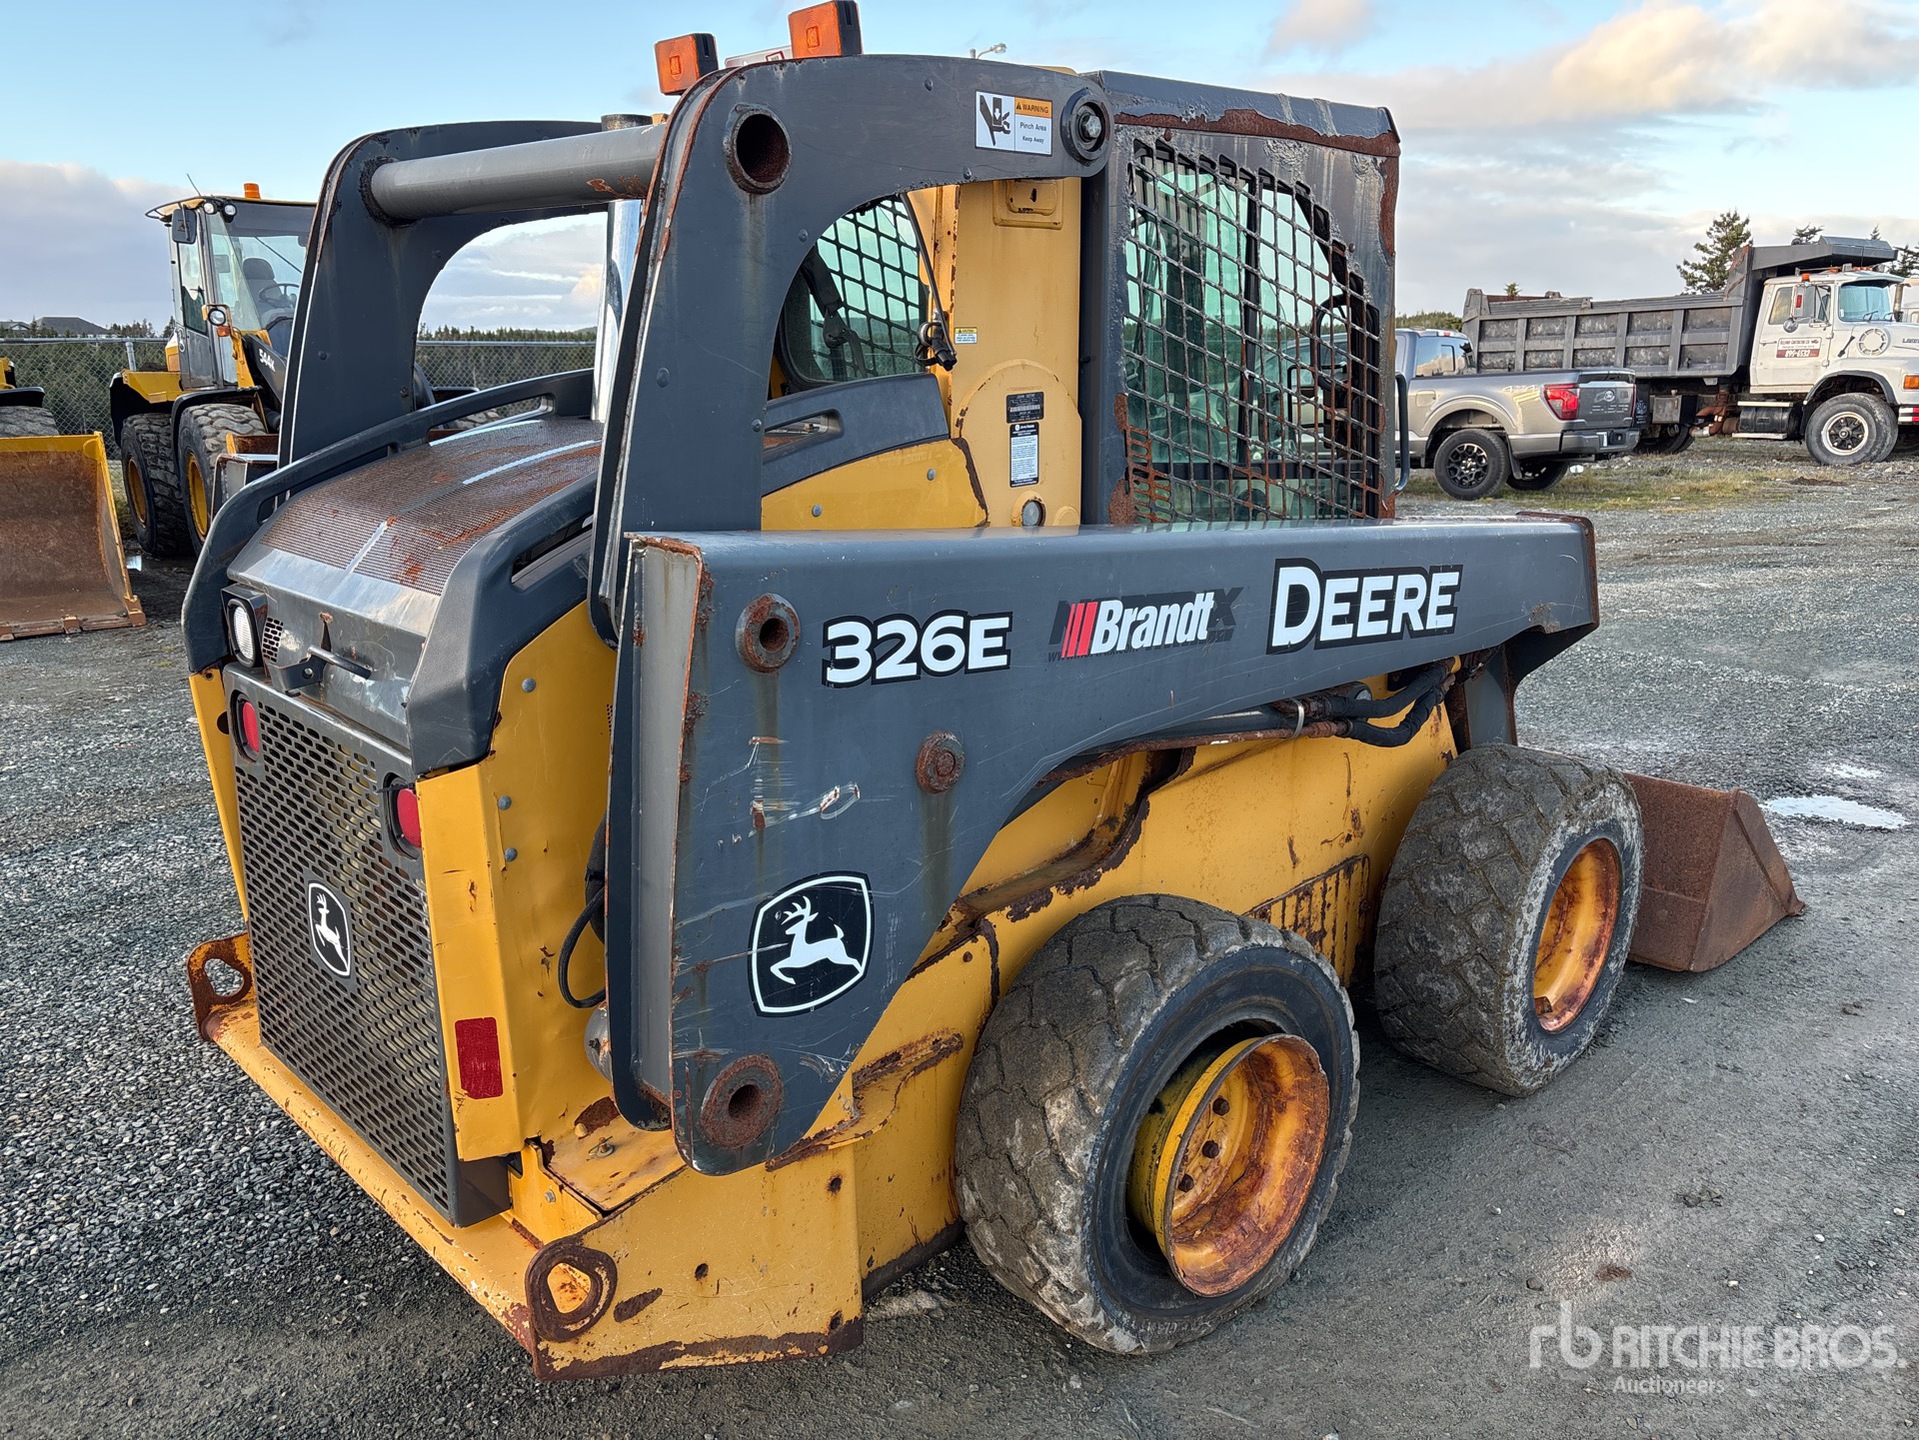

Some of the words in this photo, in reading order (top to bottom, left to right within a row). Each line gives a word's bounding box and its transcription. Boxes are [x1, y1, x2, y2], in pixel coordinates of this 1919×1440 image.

[1020, 121, 1034, 130] Pinch
[1035, 123, 1047, 131] Area
[1022, 103, 1049, 113] WARNING
[258, 348, 276, 373] 544K
[1090, 591, 1215, 655] Brandt
[1271, 566, 1460, 647] DEERE
[826, 614, 1010, 684] 326E
